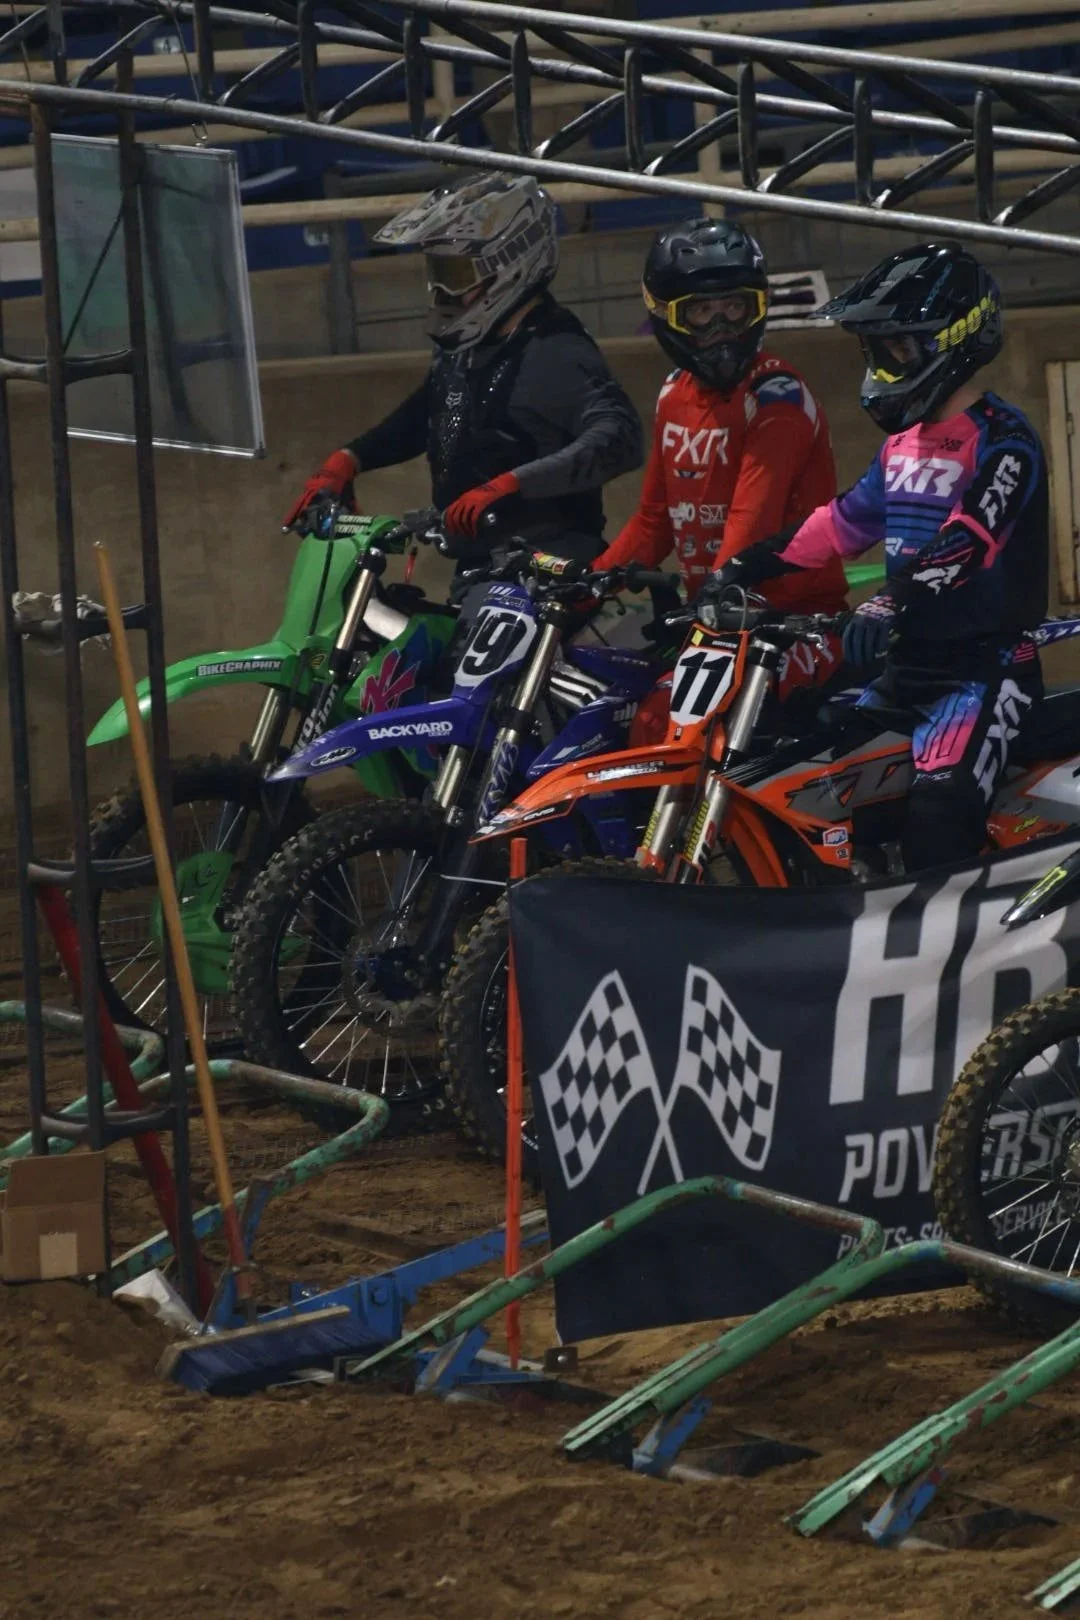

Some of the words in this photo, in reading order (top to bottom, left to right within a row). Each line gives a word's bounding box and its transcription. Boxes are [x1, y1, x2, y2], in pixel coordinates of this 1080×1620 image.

[933, 290, 997, 353] 100%
[662, 421, 729, 465] FXR
[884, 454, 964, 498] FXR
[978, 453, 1022, 530] FXR
[198, 659, 282, 677] BIKEGRAPHIX
[671, 651, 734, 717] 11
[367, 720, 454, 741] BACKYARD
